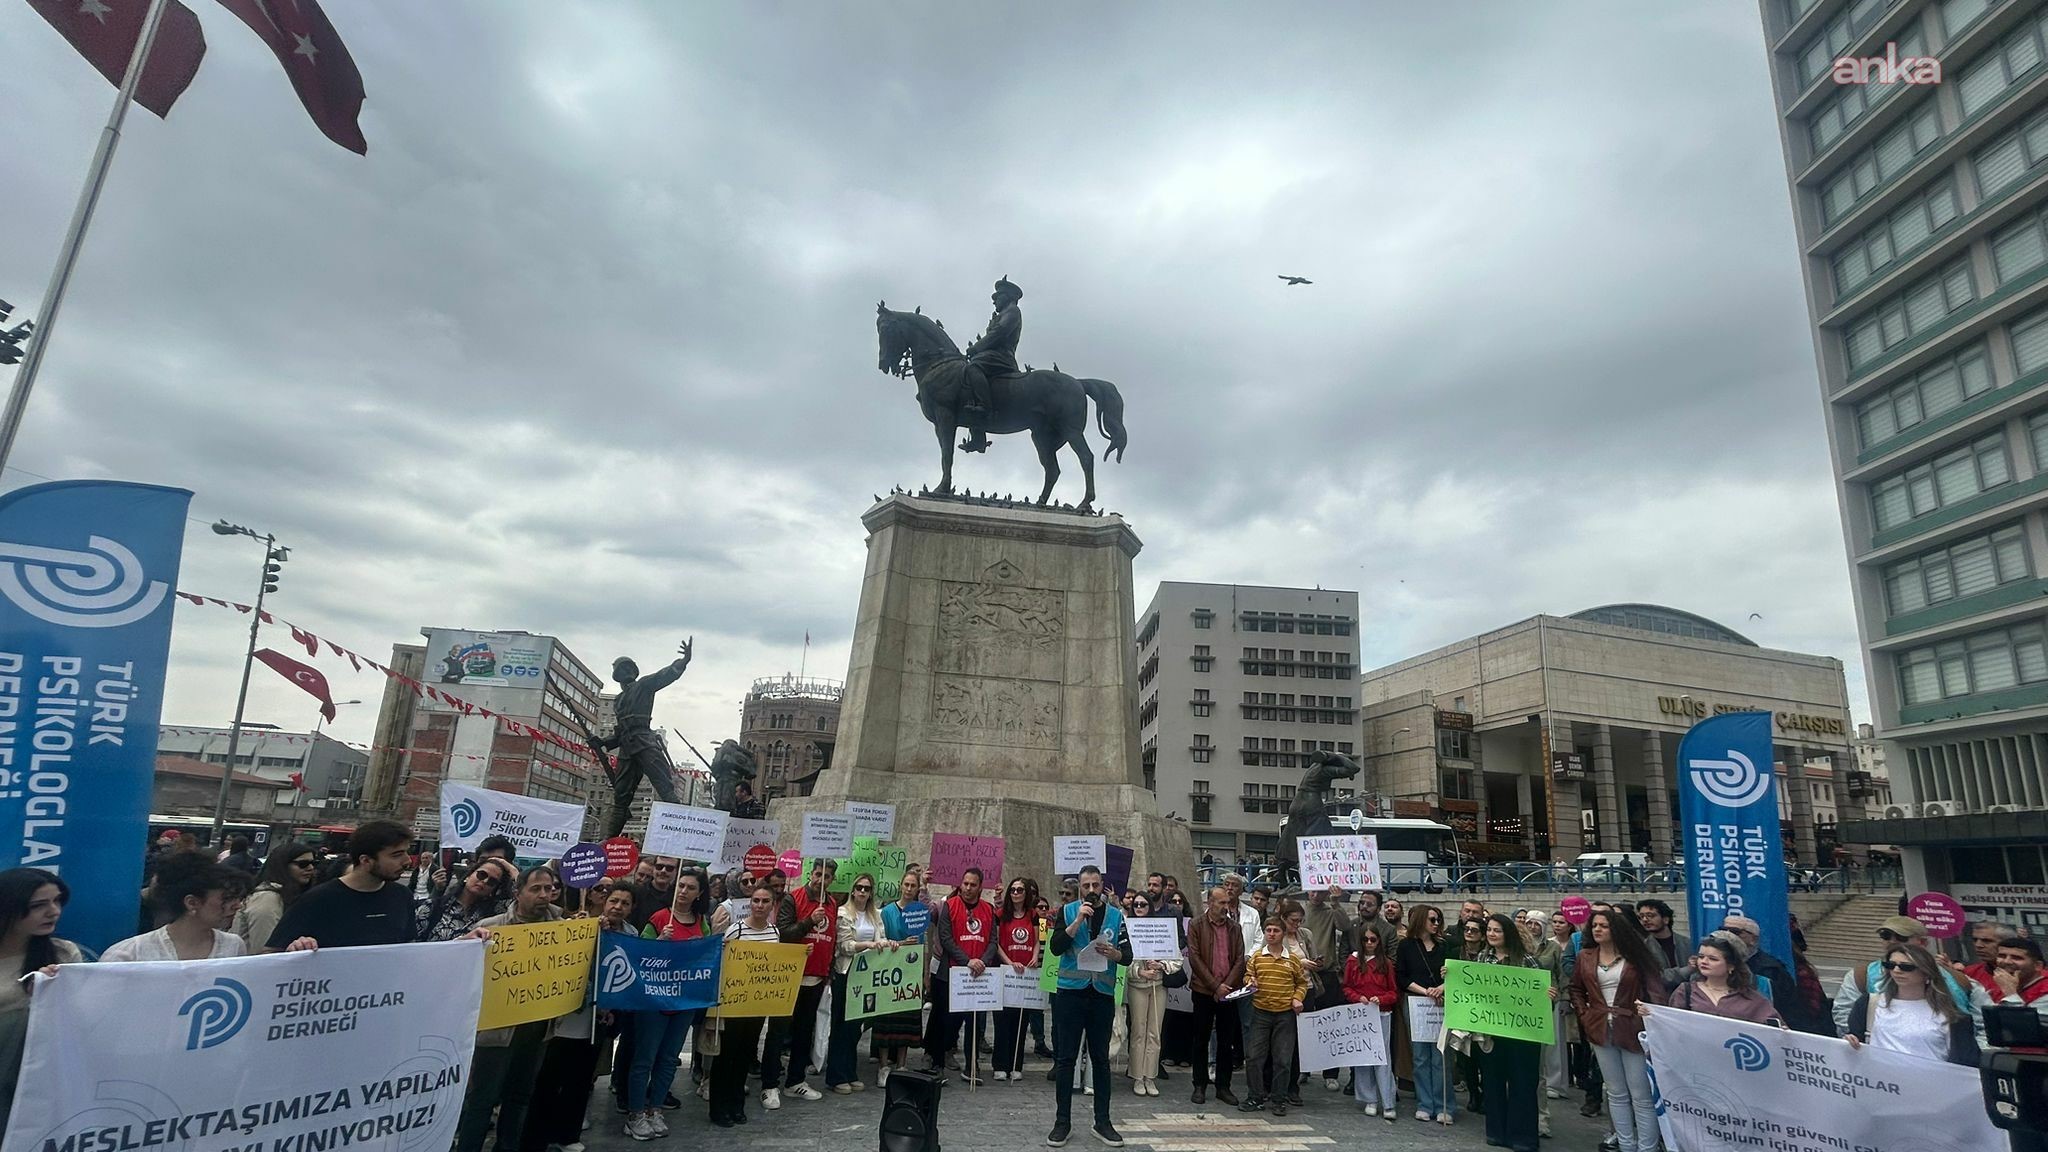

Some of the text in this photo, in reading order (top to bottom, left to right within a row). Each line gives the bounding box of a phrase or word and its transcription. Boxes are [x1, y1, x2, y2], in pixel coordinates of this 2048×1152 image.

[88, 661, 140, 747] TÜRK
[1658, 695, 1707, 718] ULUS
[1775, 711, 1846, 737] ÇARŞISI
[495, 810, 527, 824] TÜRK
[489, 822, 569, 842] PSİKOLOGLAR
[489, 833, 538, 848] DRNEĞİ
[1303, 838, 1345, 850] PSİKOLOG
[1743, 825, 1768, 879] TÜRK
[1304, 851, 1373, 861] MESLEK YASASI
[1694, 824, 1726, 909] DERNEĞİ
[491, 932, 515, 954] BİZ
[566, 924, 595, 943] DEĞİL
[491, 957, 541, 981] SAĞLIK
[640, 956, 671, 968] TÜRK
[639, 968, 712, 982] PSİKOLOGLAR
[872, 967, 903, 988] EGO
[1462, 965, 1541, 990] SAHADAYIZ
[275, 978, 332, 998] TÜRK
[644, 981, 682, 997] DERNEĞİ
[891, 982, 921, 1002] YASA
[271, 991, 405, 1020] PSİKOLOGLAR
[1510, 998, 1533, 1007] YOK
[267, 1011, 358, 1041] DERNEĞİ
[1470, 1007, 1544, 1030] SAYILIYORUZ
[1781, 1047, 1826, 1065] TÜRK
[1784, 1060, 1901, 1096] PSİKOLOGLAR
[1787, 1072, 1857, 1099] DERNEĞİ
[42, 1064, 460, 1152] MESLEKTAŞIMIZA YAPILAN
[268, 1103, 436, 1152] KINIYORUZ!
[1663, 1098, 1747, 1128] Psikologlar
[1752, 1117, 1781, 1134] için
[1785, 1125, 1849, 1151] güvenli
[1706, 1125, 1764, 1147] toplum
[1768, 1136, 1798, 1152] için
